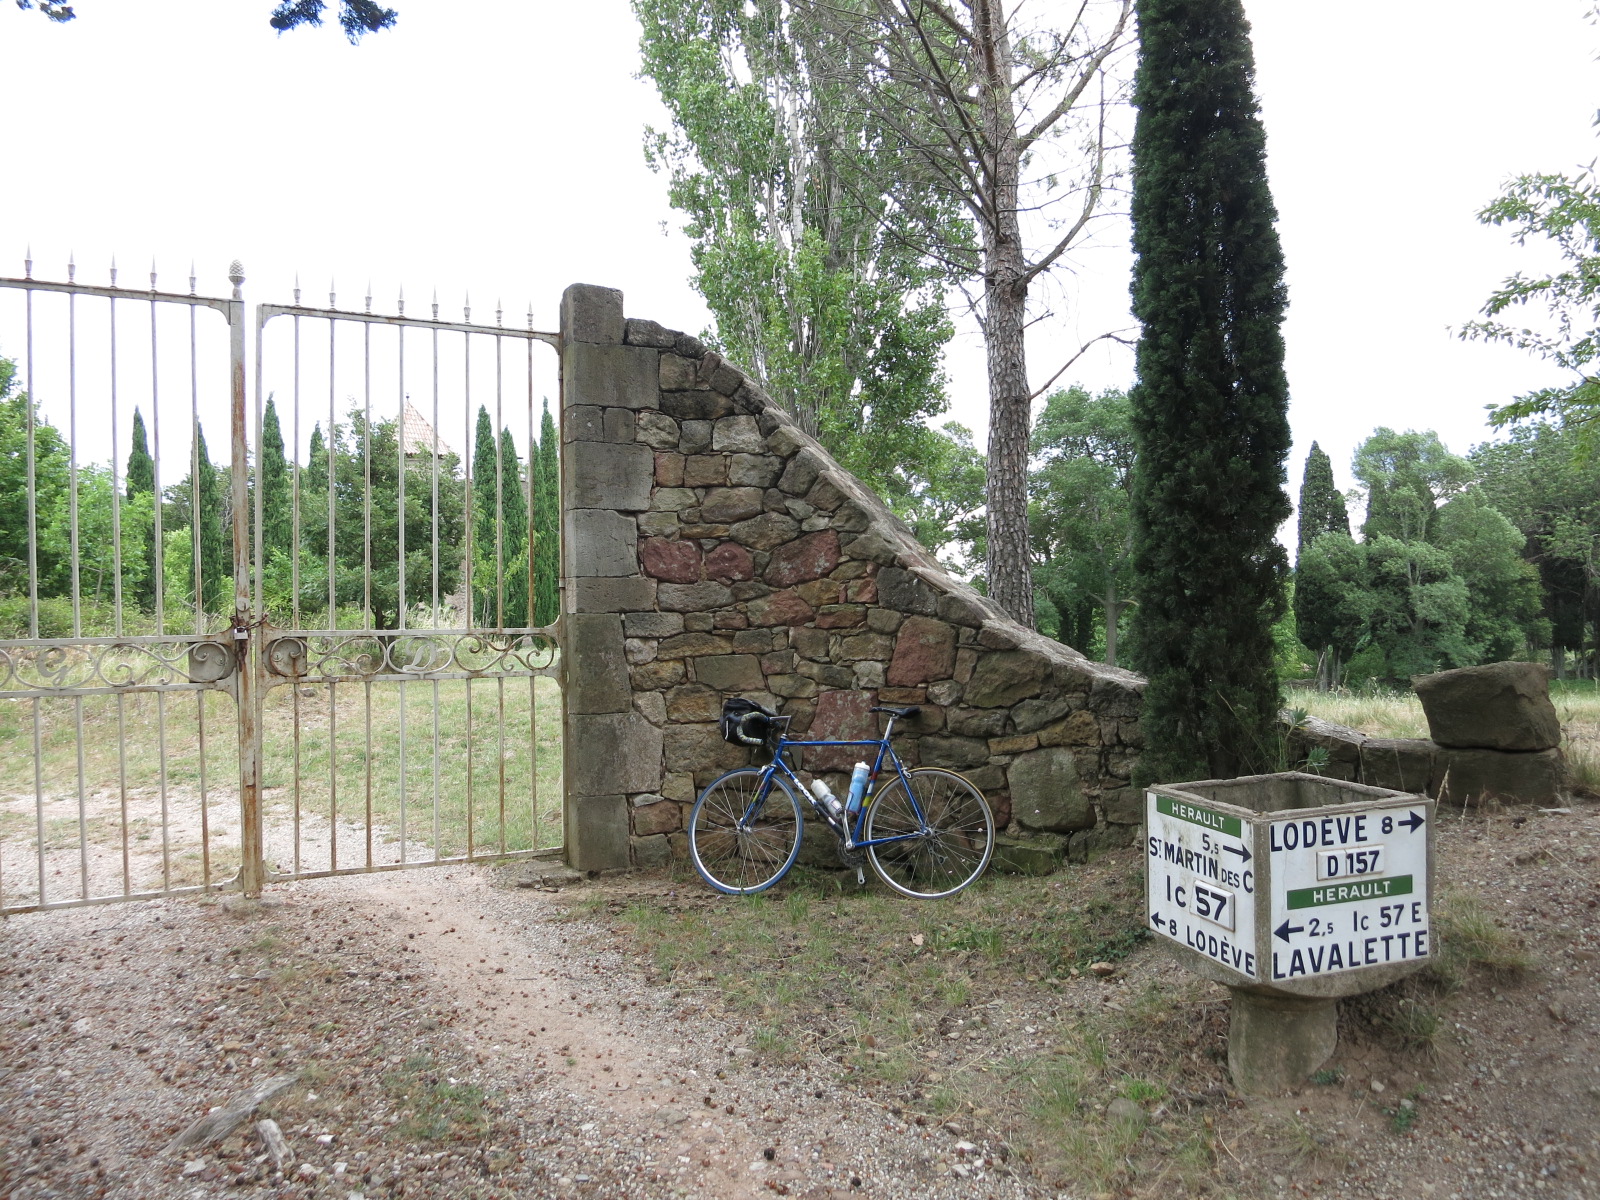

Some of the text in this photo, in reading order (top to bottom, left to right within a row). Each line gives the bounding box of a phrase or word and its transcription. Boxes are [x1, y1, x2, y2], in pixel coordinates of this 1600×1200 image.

[1171, 802, 1225, 829] HERAULT
[1202, 833, 1220, 855] 5,5
[1270, 815, 1394, 852] LODÈVE 8
[1164, 841, 1219, 880] MARTIN
[1221, 869, 1240, 889] DES
[1243, 870, 1254, 894] C
[1327, 850, 1380, 877] D 157
[1195, 886, 1227, 921] 57
[1313, 880, 1391, 903] HERAULT
[1308, 918, 1334, 938] 2,5
[1379, 904, 1405, 928] 57
[1411, 902, 1422, 923] E
[1168, 918, 1256, 977] 8 LODÈVE
[1273, 930, 1428, 980] LAVALETTE
